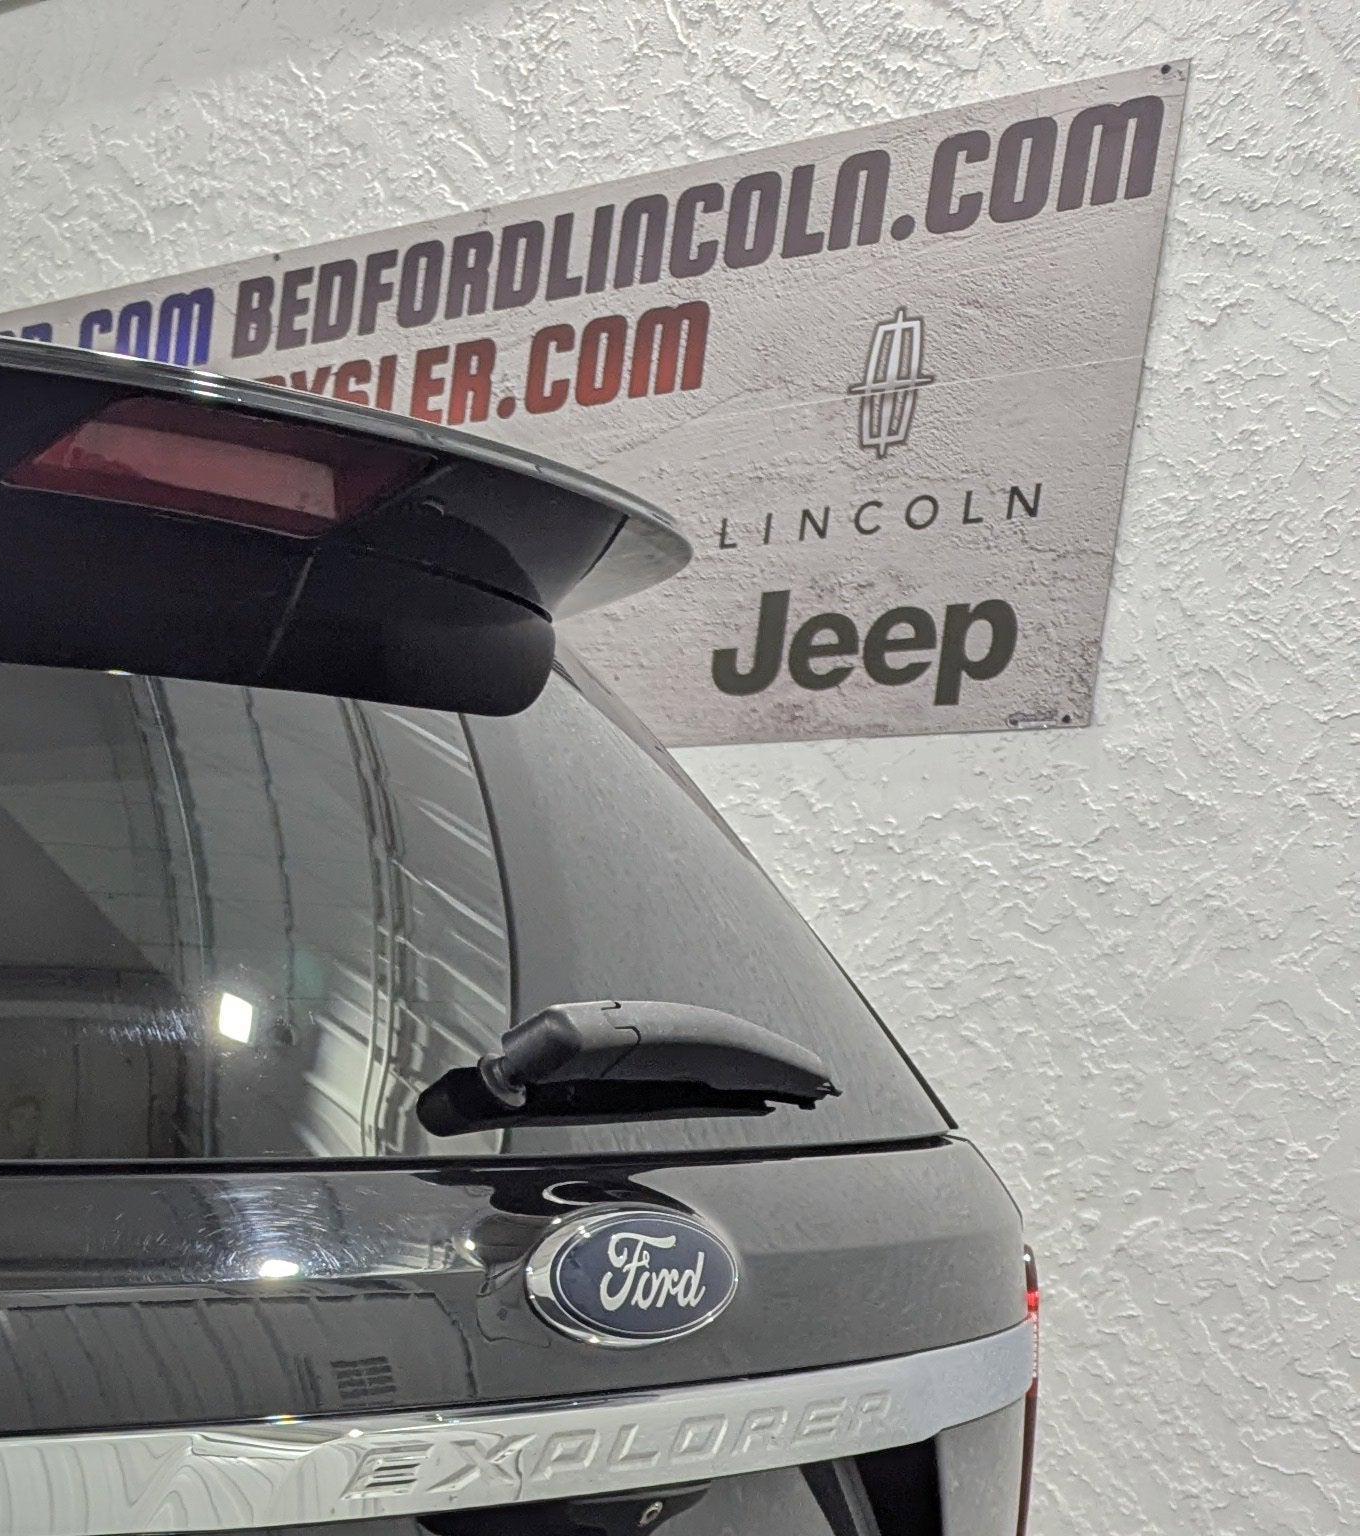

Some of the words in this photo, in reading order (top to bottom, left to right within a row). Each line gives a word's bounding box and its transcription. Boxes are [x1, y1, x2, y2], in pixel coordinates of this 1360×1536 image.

[231, 95, 1166, 359] BEDFORDLINCOLN.COM
[716, 482, 1042, 550] LINCOLN
[711, 590, 1018, 706] Jeep
[600, 1232, 706, 1311] Ford
[340, 1388, 892, 1500] EXPLORER
